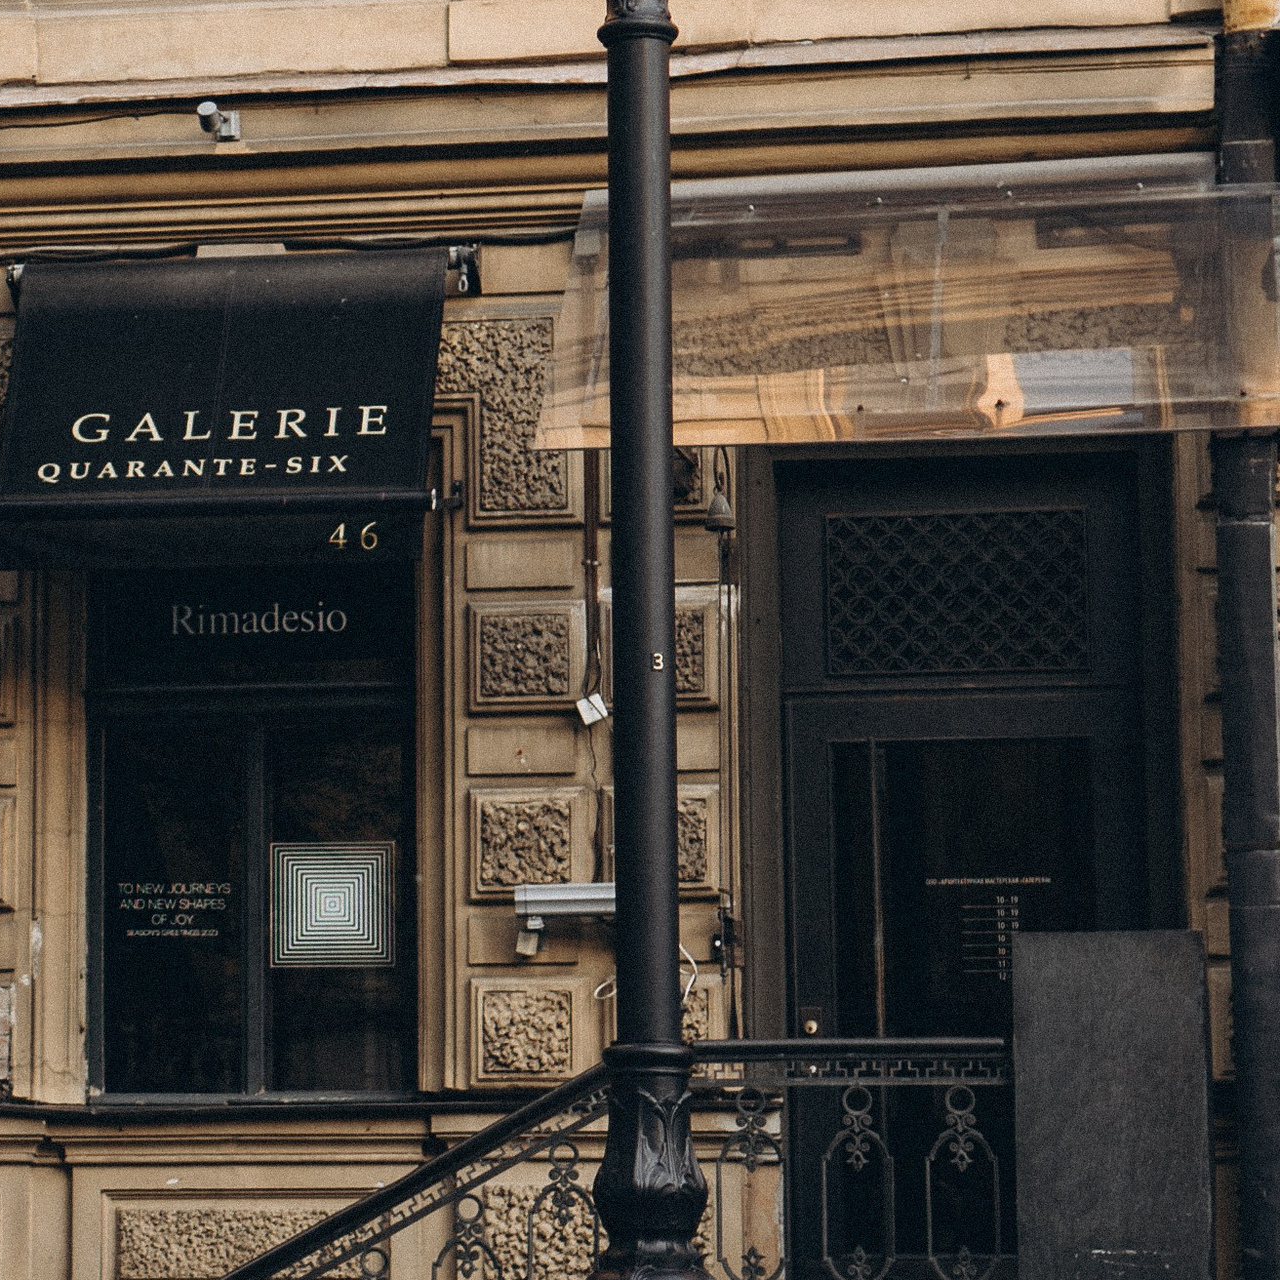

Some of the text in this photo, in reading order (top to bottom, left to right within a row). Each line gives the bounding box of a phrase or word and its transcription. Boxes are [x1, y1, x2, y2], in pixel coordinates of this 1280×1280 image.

[71, 404, 388, 443] GALERIE
[37, 455, 350, 484] QUARANTE-SIX
[171, 601, 348, 635] Rimadesio
[653, 652, 664, 670] 3
[118, 883, 231, 894] TO NEW JOURNEYS
[120, 898, 226, 910] AND NEW SHAPES
[151, 914, 195, 926] OF JOY
